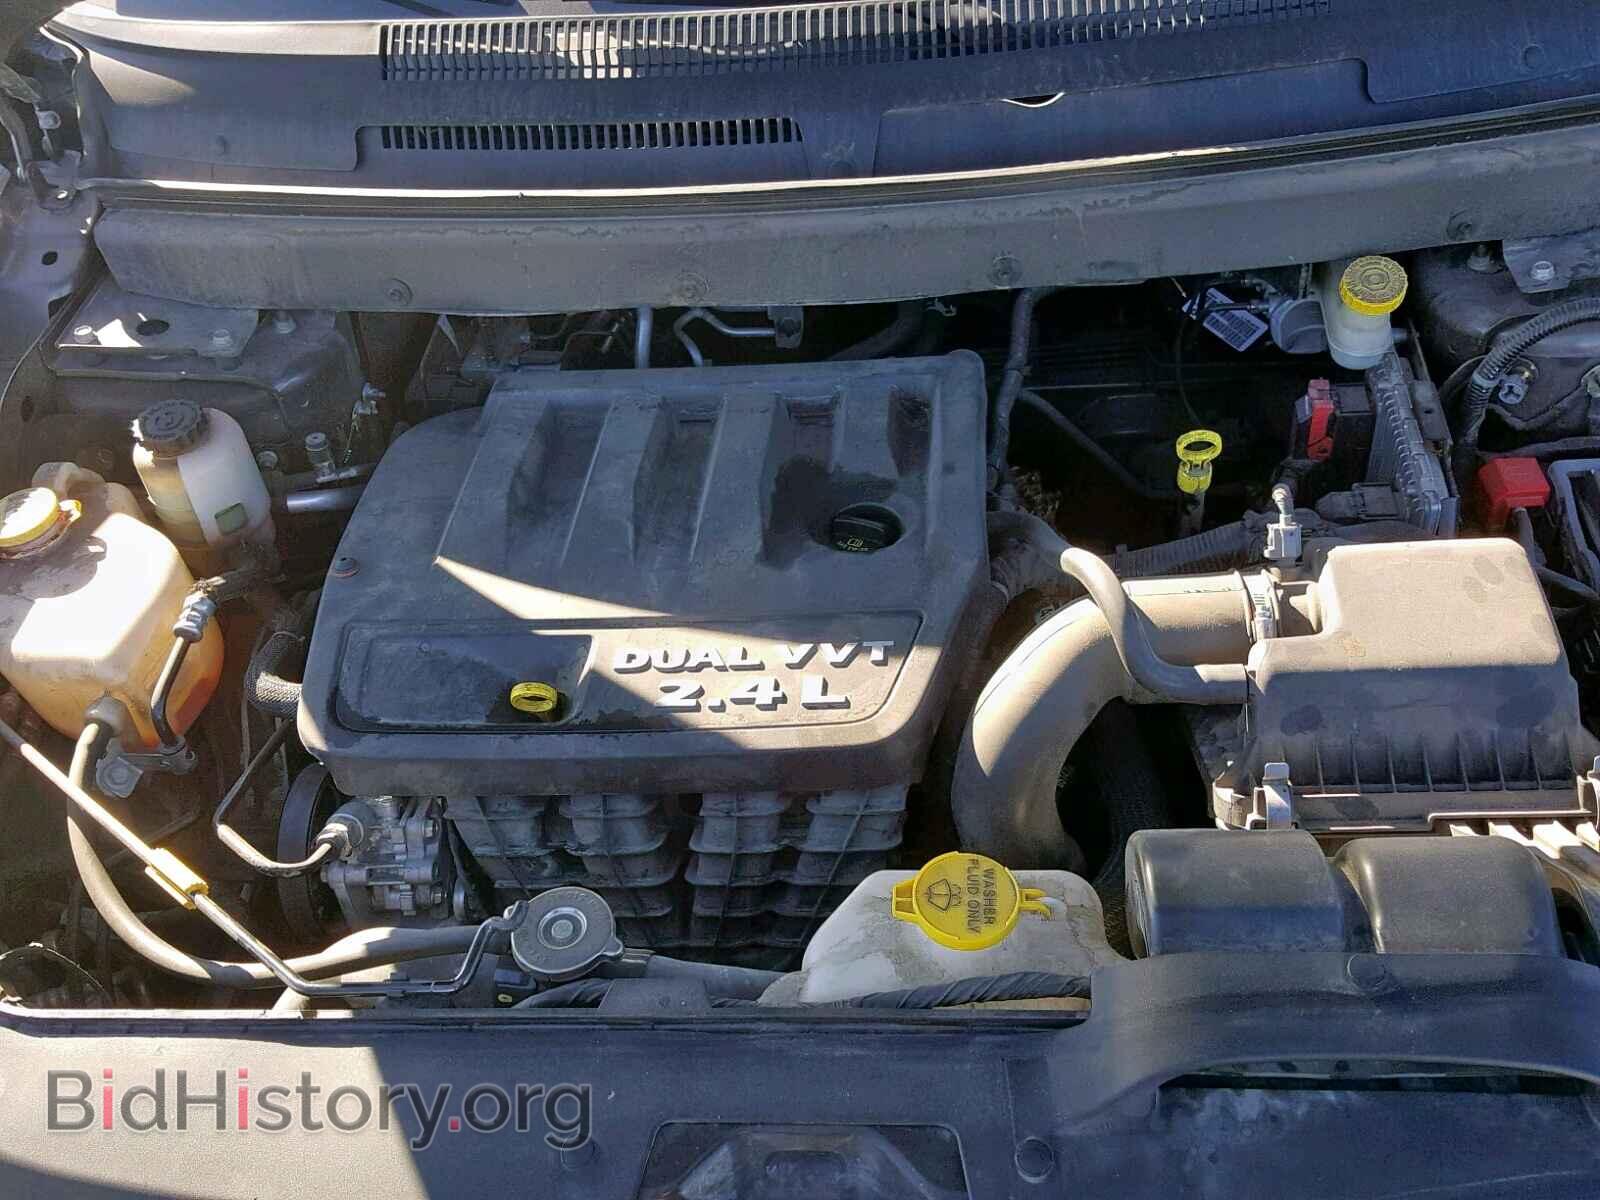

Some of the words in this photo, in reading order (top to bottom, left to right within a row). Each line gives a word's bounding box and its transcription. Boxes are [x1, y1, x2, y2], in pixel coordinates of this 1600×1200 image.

[613, 648, 765, 673] DUAL
[774, 641, 894, 669] VVT
[966, 858, 981, 896] FLUID
[983, 868, 998, 925] WASHER
[967, 899, 982, 934] ONLY
